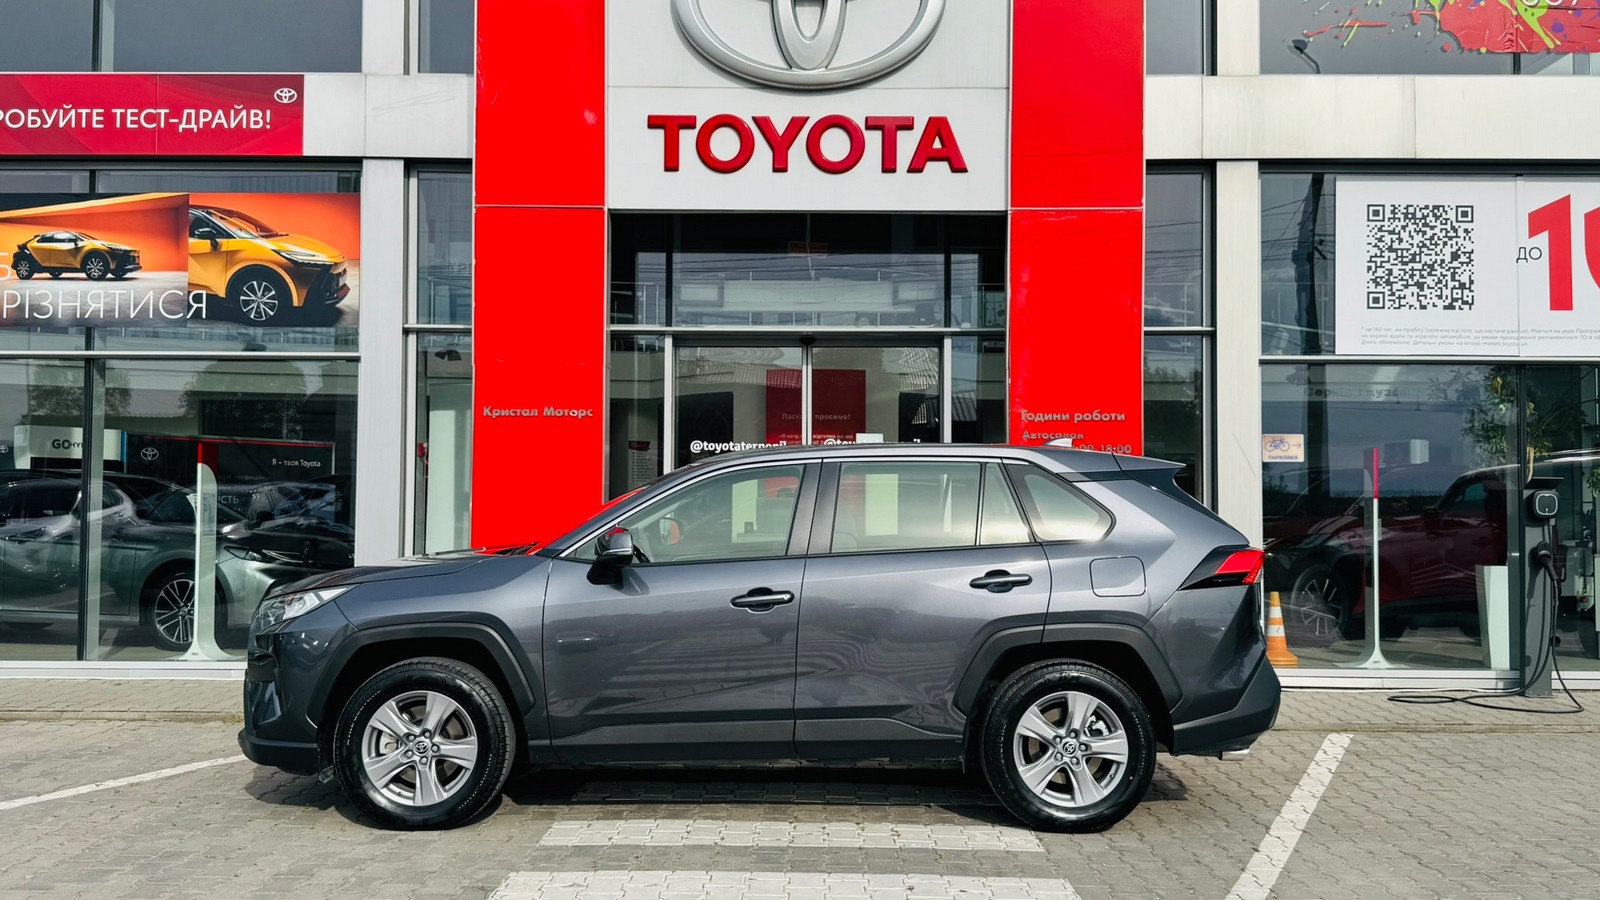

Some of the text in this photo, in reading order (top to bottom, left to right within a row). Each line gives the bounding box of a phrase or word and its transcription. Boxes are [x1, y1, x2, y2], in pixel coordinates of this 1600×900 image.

[112, 104, 271, 133] ТЕСТ-ДРАЙВ!
[647, 113, 969, 175] TOYOTA
[3, 290, 207, 319] РІЗНЯТИСЯ
[483, 406, 594, 419] Кристал Моторс
[1021, 409, 1126, 424] Години роботи
[1101, 443, 1132, 455] 18:00
[300, 459, 322, 468] Toyota
